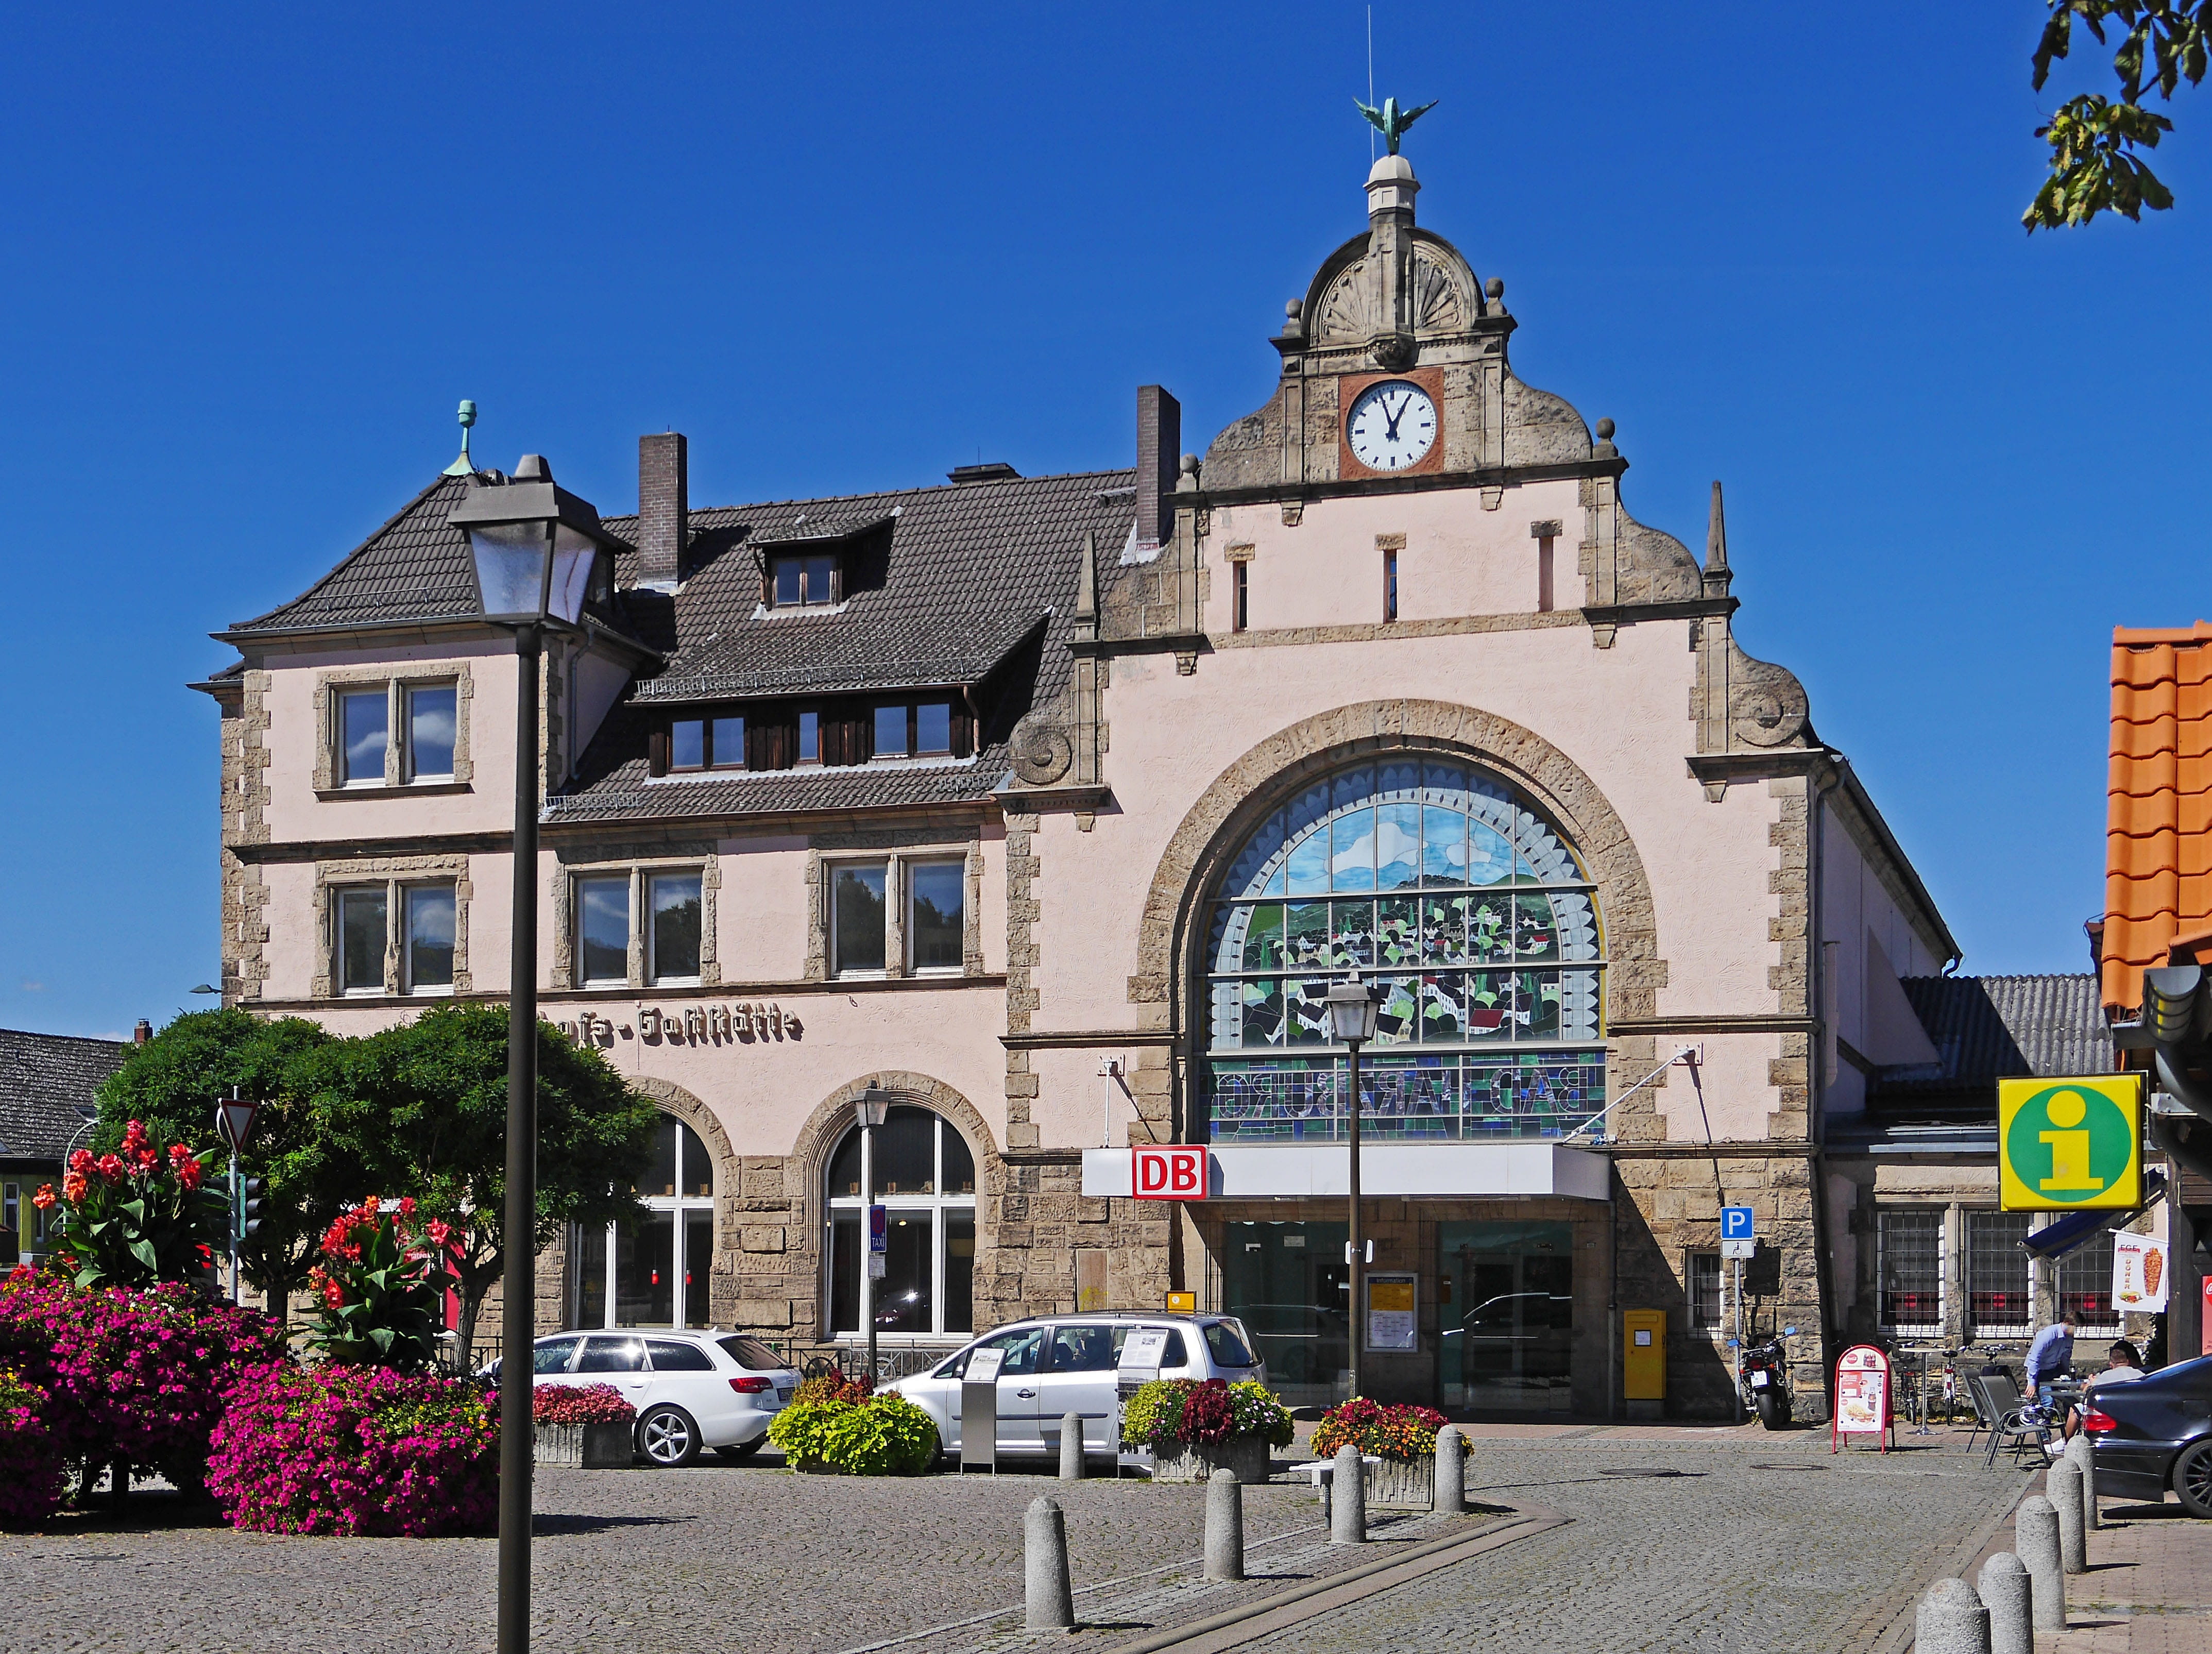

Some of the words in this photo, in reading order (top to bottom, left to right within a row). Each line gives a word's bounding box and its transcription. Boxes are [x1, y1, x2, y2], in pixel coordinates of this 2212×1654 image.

[1142, 1155, 1197, 1190] DB
[1728, 1211, 1745, 1235] P
[872, 1237, 884, 1247] TAXI
